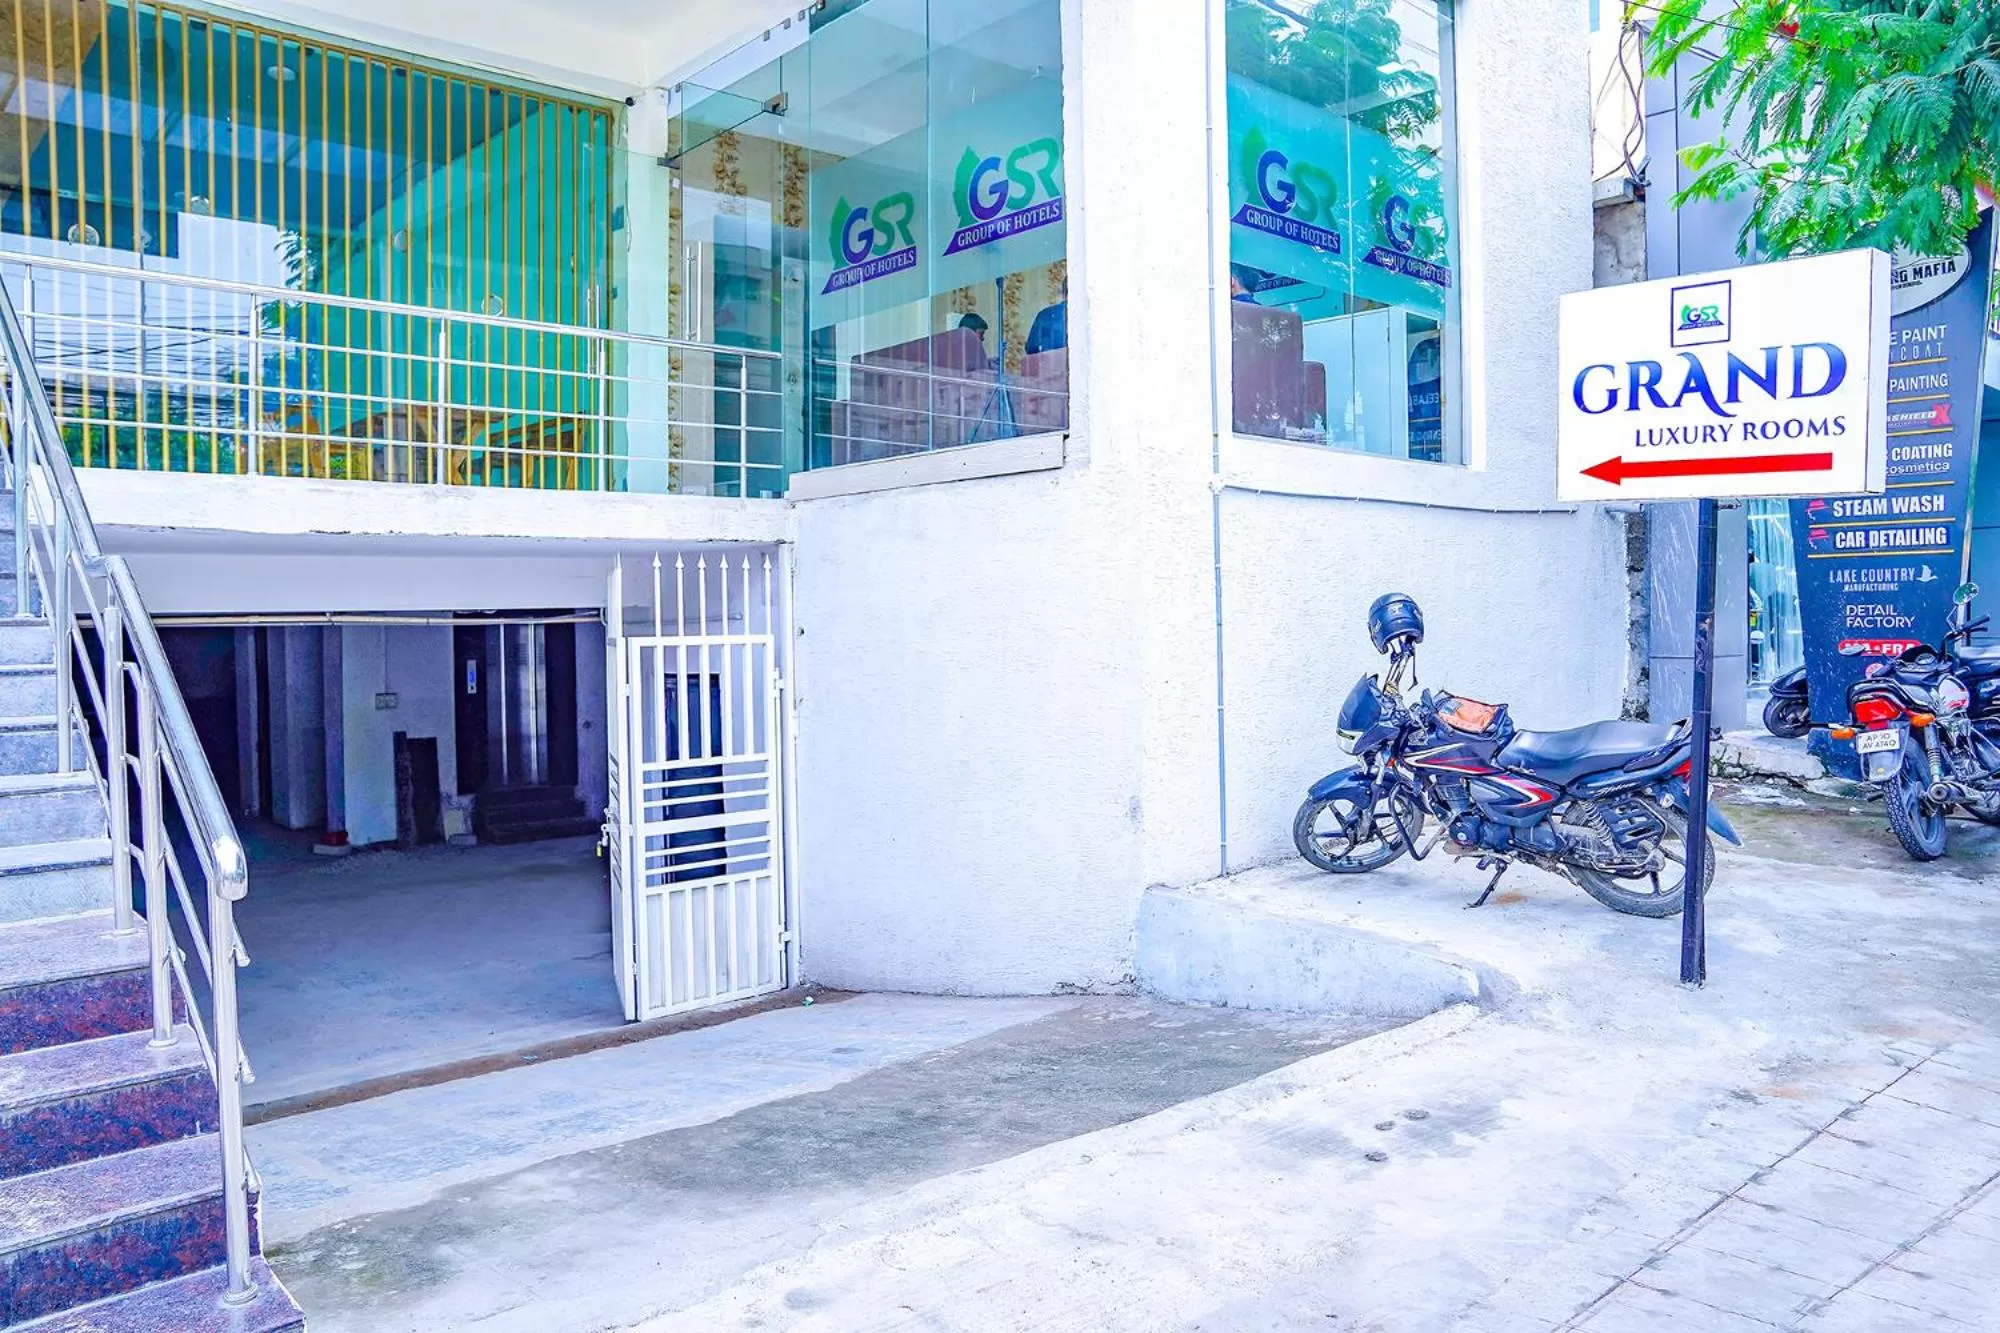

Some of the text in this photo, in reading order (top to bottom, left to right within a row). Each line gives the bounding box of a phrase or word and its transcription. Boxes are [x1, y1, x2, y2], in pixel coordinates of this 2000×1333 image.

[969, 137, 1060, 220] GSR
[1257, 150, 1338, 230] GSR
[842, 191, 917, 265] GSR
[957, 204, 1060, 247] GROUP OF HOTELS
[1246, 209, 1338, 249] GROUP OF HOTELS
[832, 250, 915, 289] GROUP OF HOTELS
[1913, 260, 1956, 280] MAFIA
[1687, 305, 1719, 322] GSR
[1902, 324, 1948, 343] PAINT
[1573, 341, 1847, 417] GRAND
[1890, 373, 1949, 393] PAINTING
[1635, 416, 1847, 448] LUXURY ROOMS
[1891, 443, 1953, 461] COATING
[1832, 495, 1945, 518] STEAM WASH
[1835, 527, 1947, 549] CAR DETAILING
[1829, 567, 1916, 584] LAKE COUNTRY
[1843, 582, 1899, 593] MANUFACTURING
[1846, 604, 1898, 616] DETAIL
[1846, 615, 1916, 629] FACTORY
